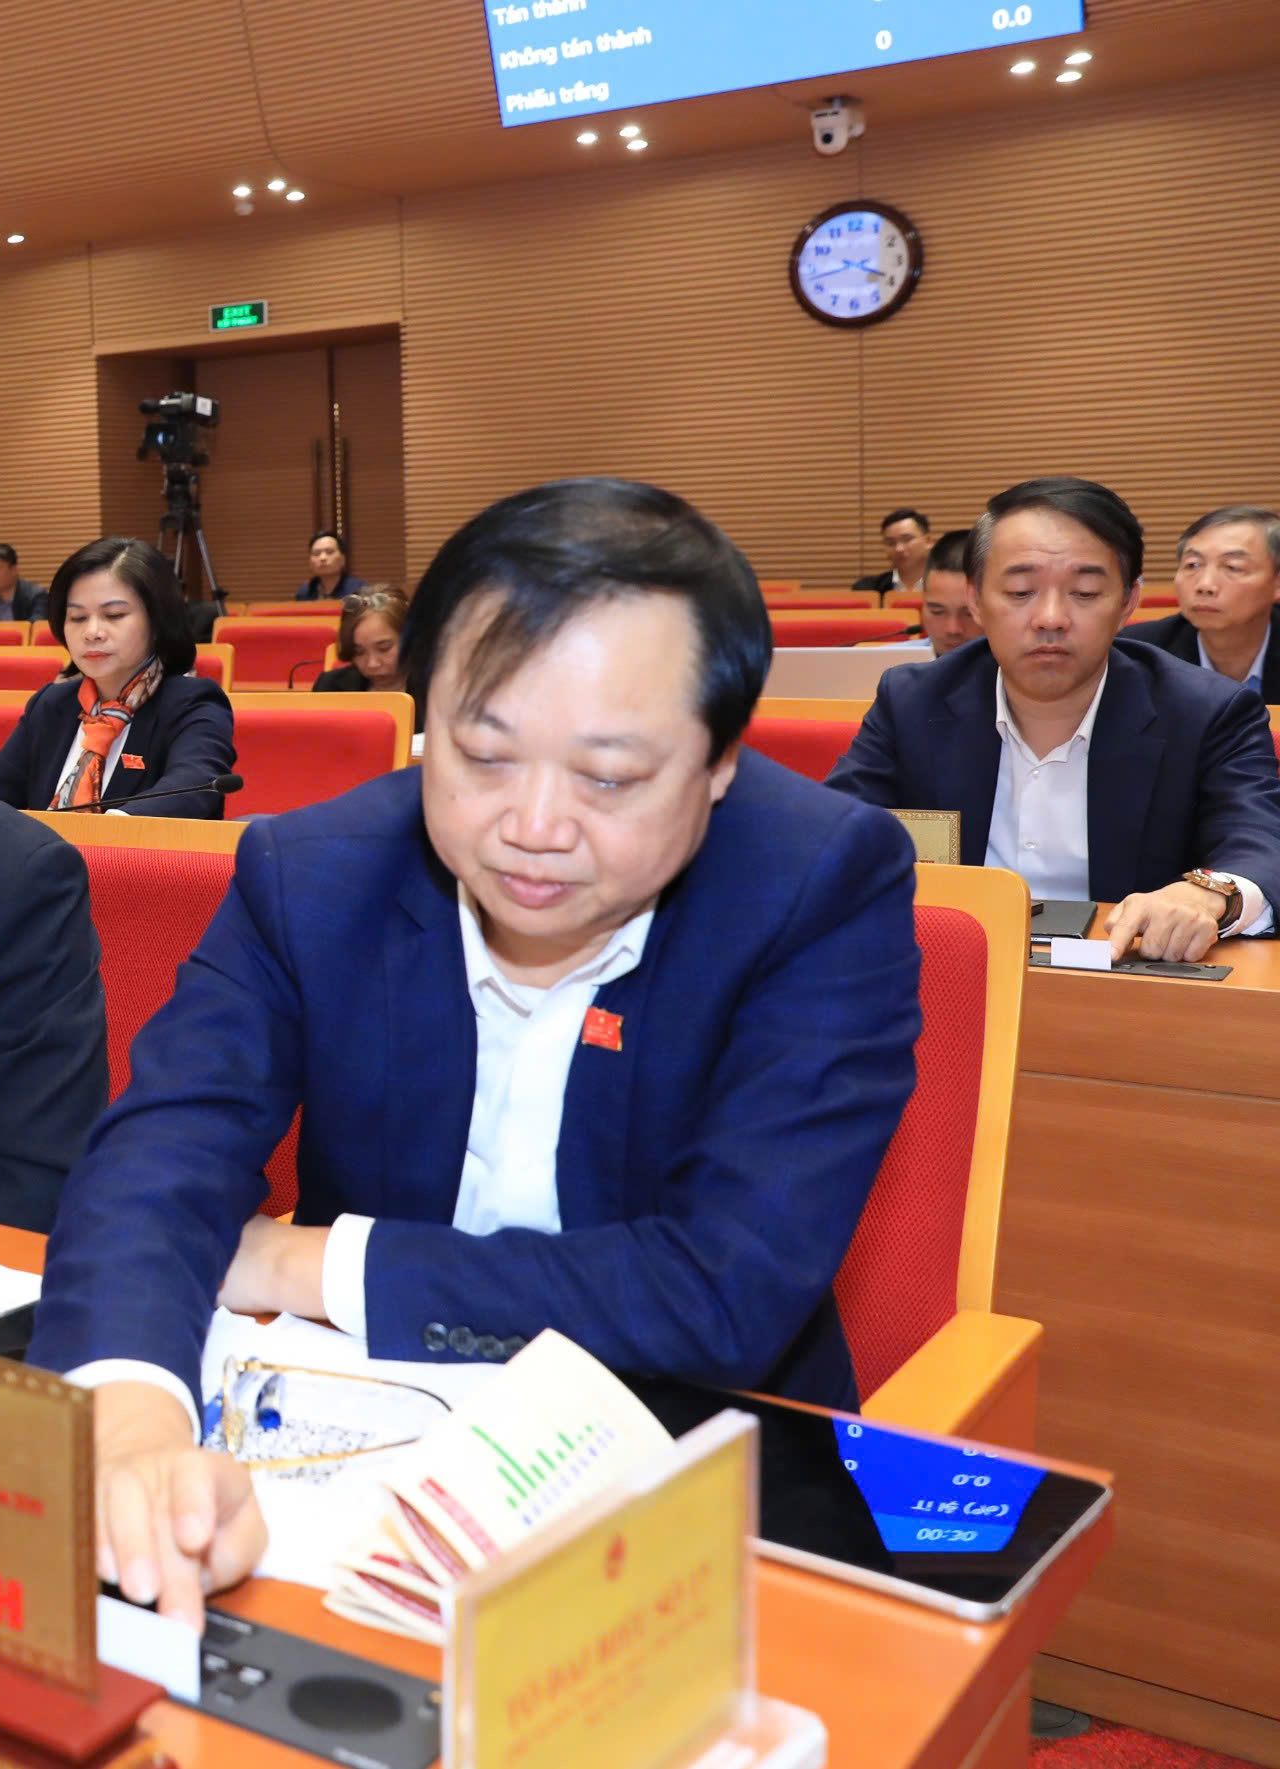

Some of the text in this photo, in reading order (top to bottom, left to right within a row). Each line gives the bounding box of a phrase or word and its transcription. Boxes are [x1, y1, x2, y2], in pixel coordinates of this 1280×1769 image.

[991, 4, 1033, 30] 0.0
[499, 26, 652, 70] Không tán thành
[875, 29, 892, 50] 0
[505, 80, 610, 113] Phiếu trắng
[847, 219, 863, 232] 12
